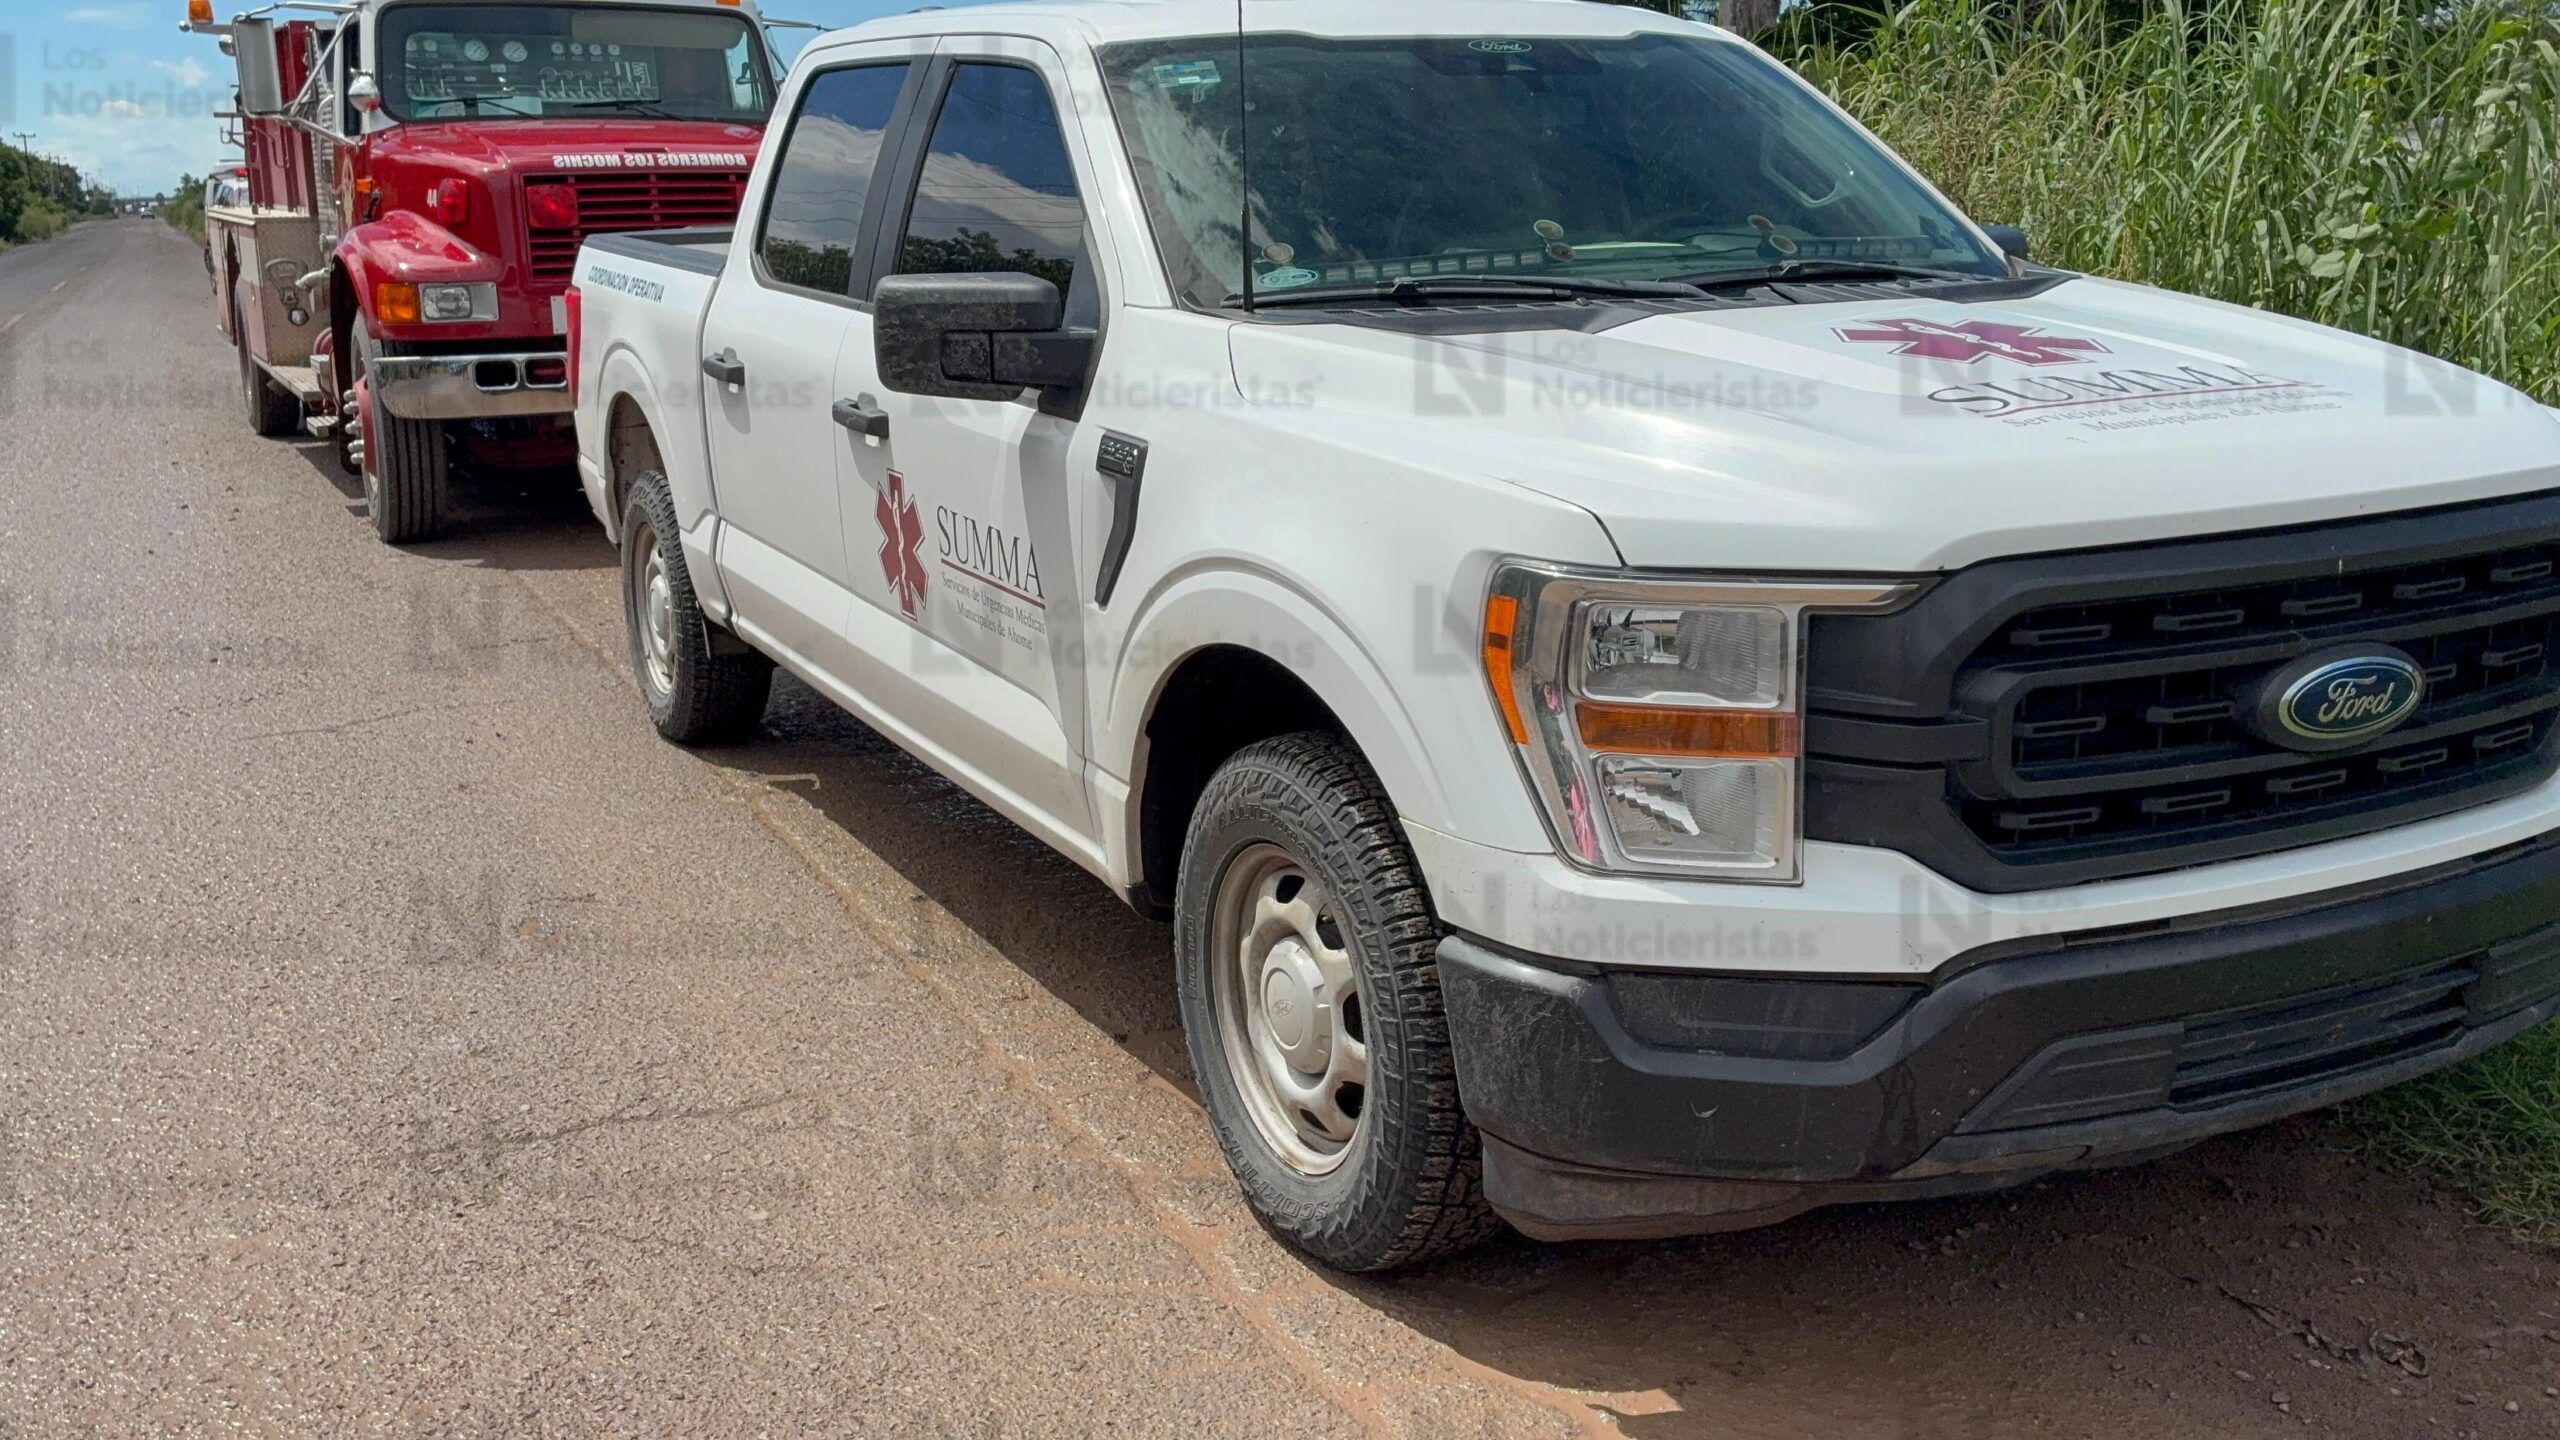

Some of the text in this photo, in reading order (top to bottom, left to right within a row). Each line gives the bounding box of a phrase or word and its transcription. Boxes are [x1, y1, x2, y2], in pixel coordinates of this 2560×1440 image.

[1481, 38, 1522, 51] Ford
[627, 277, 665, 303] OPERATIVA
[1928, 364, 2320, 414] SUMMA
[2002, 408, 2118, 428] Servicios
[2081, 411, 2229, 432] Municipales
[937, 505, 1045, 600] SUMMA
[941, 570, 1046, 635] Servicios de Urgencias Médicas
[956, 601, 1033, 650] Municipales de Ahome
[2318, 674, 2396, 723] Ford
